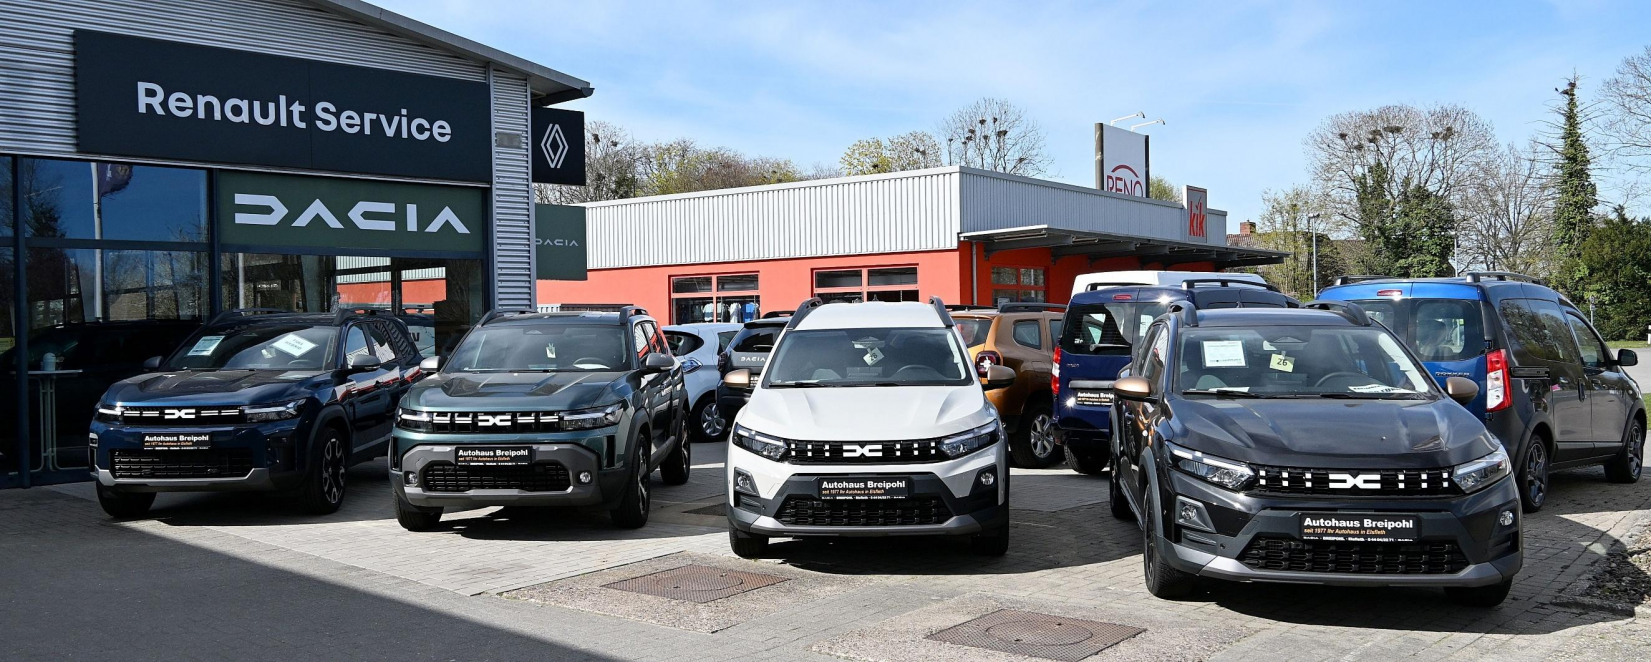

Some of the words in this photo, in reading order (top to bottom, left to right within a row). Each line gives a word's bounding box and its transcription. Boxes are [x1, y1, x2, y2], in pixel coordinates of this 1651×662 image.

[137, 81, 306, 129] Renault
[315, 101, 452, 142] Service
[234, 193, 470, 234] DACIA
[1276, 357, 1288, 366] 26
[496, 449, 528, 457] Breipohl
[822, 481, 865, 489] Autohaus
[867, 480, 906, 490] Breipohl
[1303, 517, 1360, 528] Autohaus
[1363, 519, 1413, 530] Breipohl
